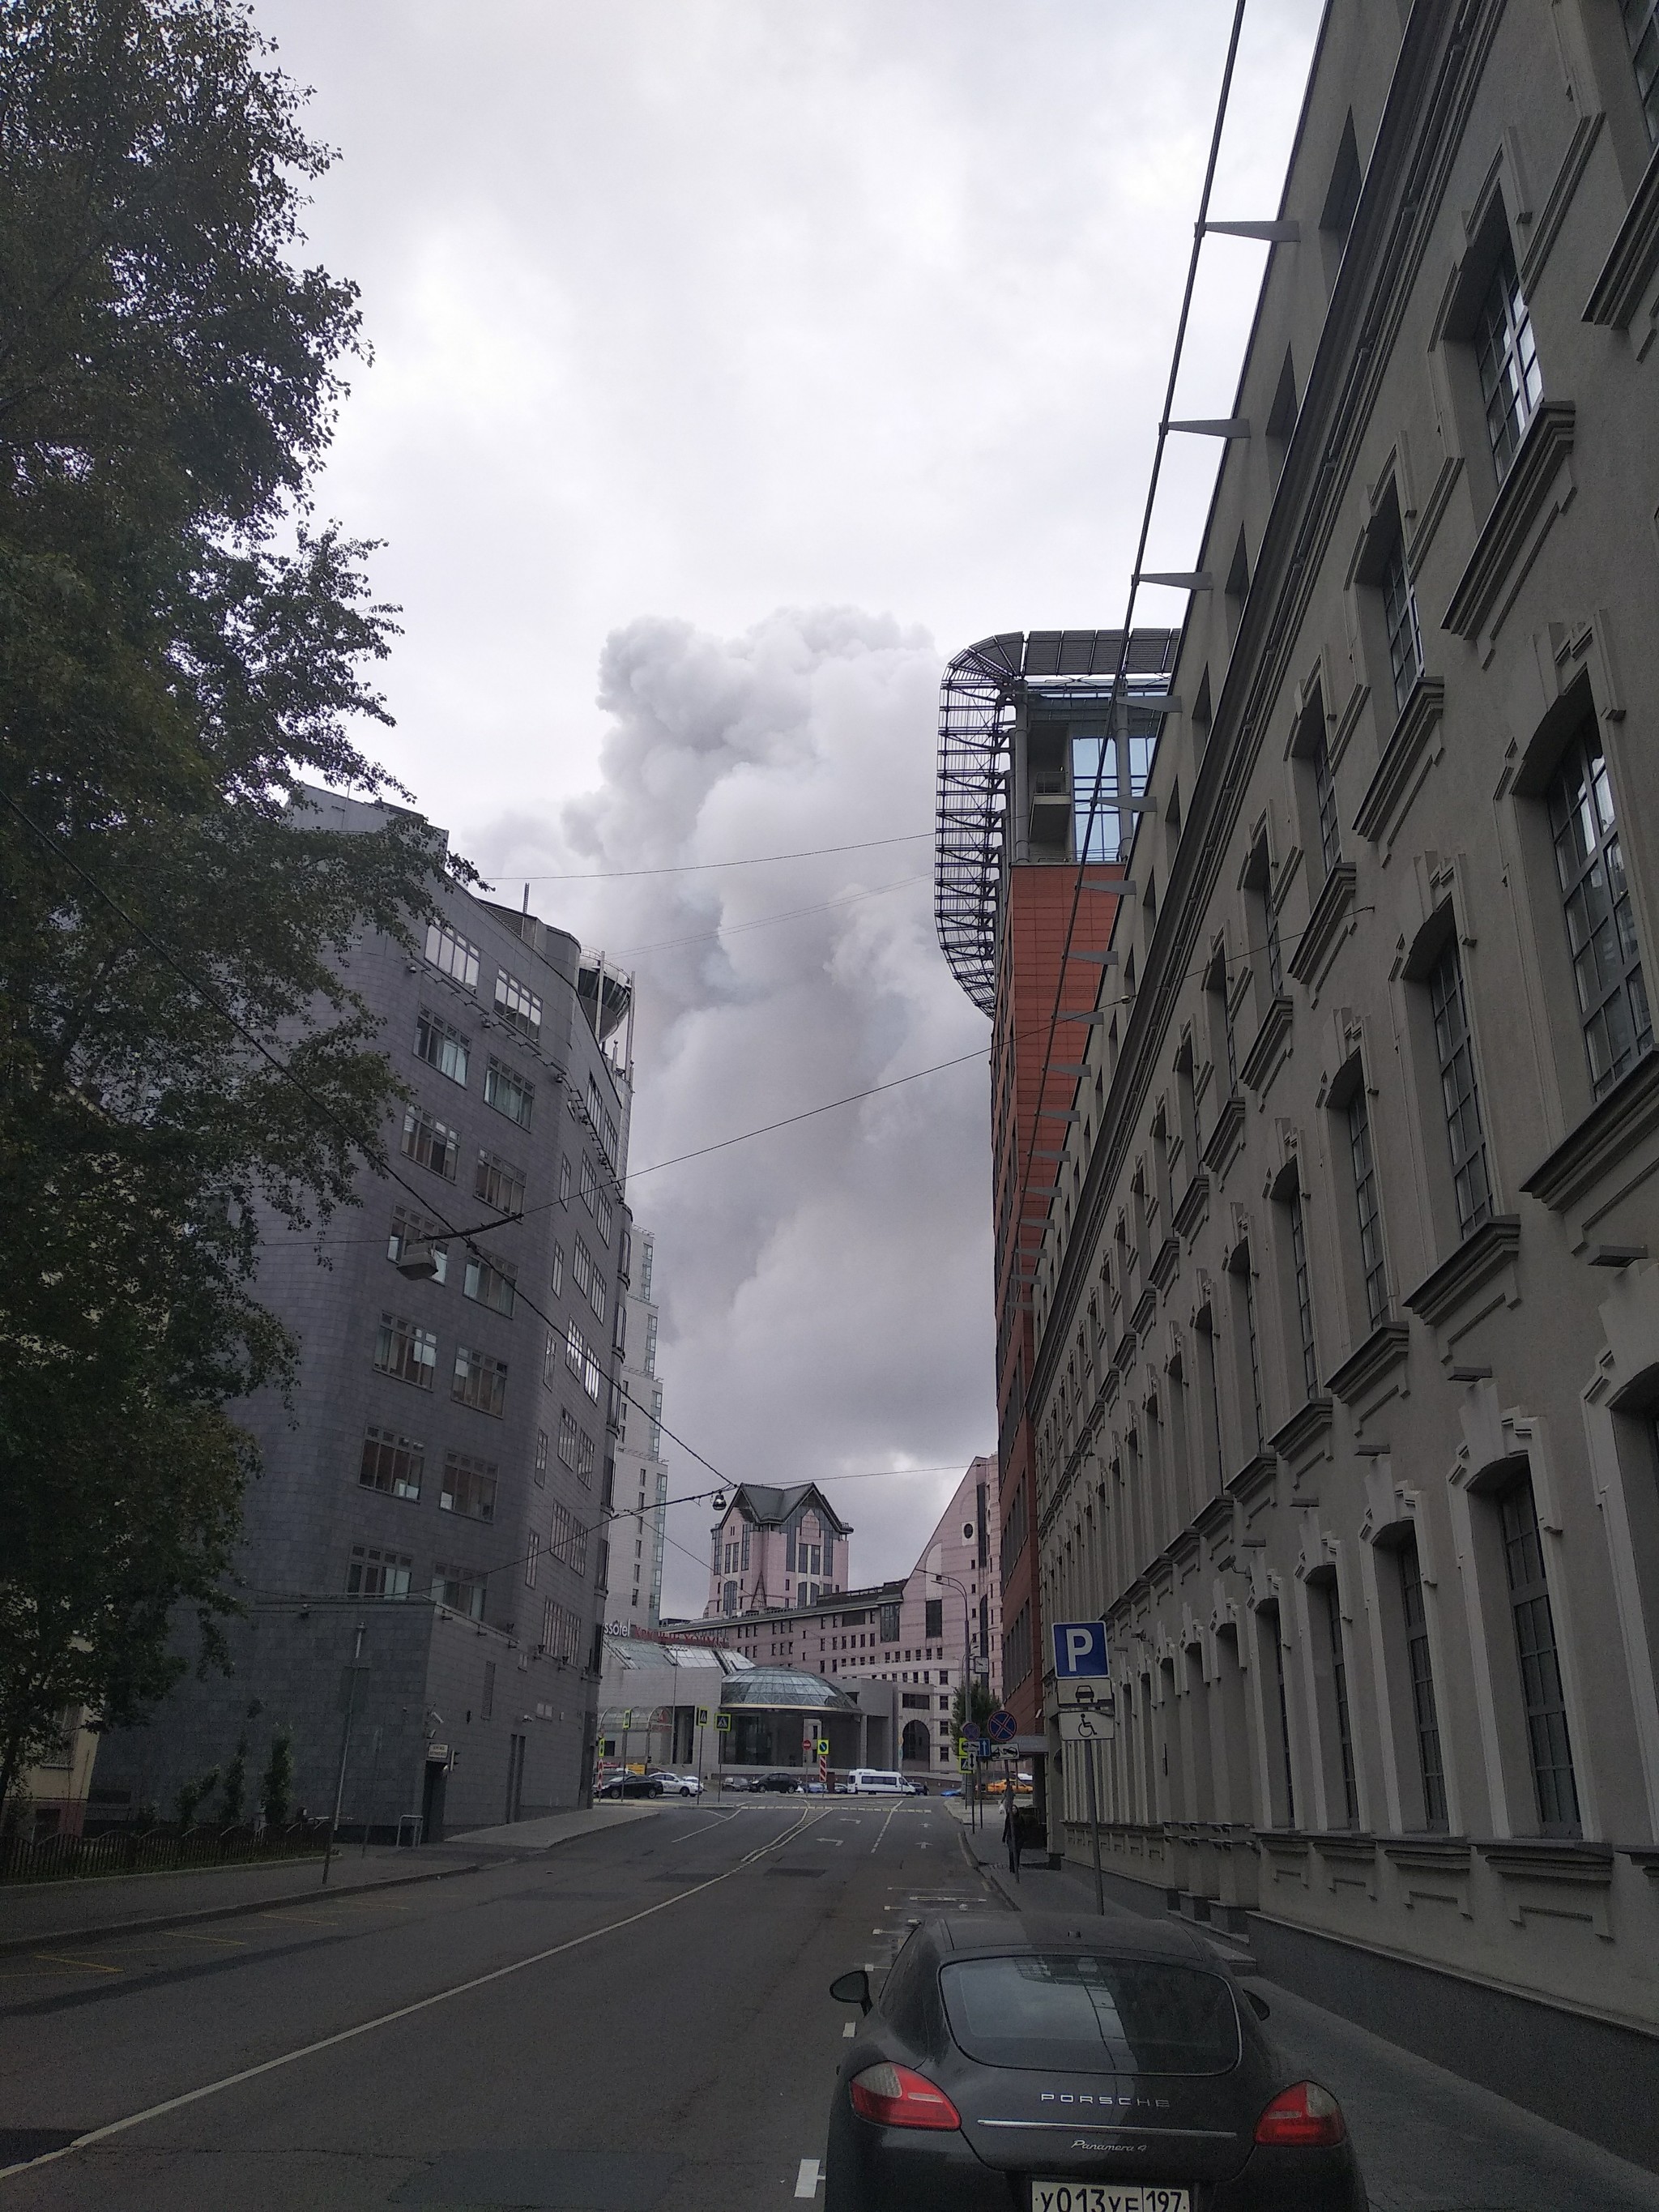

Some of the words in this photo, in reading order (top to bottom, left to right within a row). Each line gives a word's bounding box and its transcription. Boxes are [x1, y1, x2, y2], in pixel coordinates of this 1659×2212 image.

[1066, 1629, 1094, 1672] P
[1041, 2093, 1170, 2107] PORSCHE
[1071, 2140, 1135, 2152] Panamera
[1137, 2144, 1147, 2152] 4
[1145, 2189, 1182, 2212] 197
